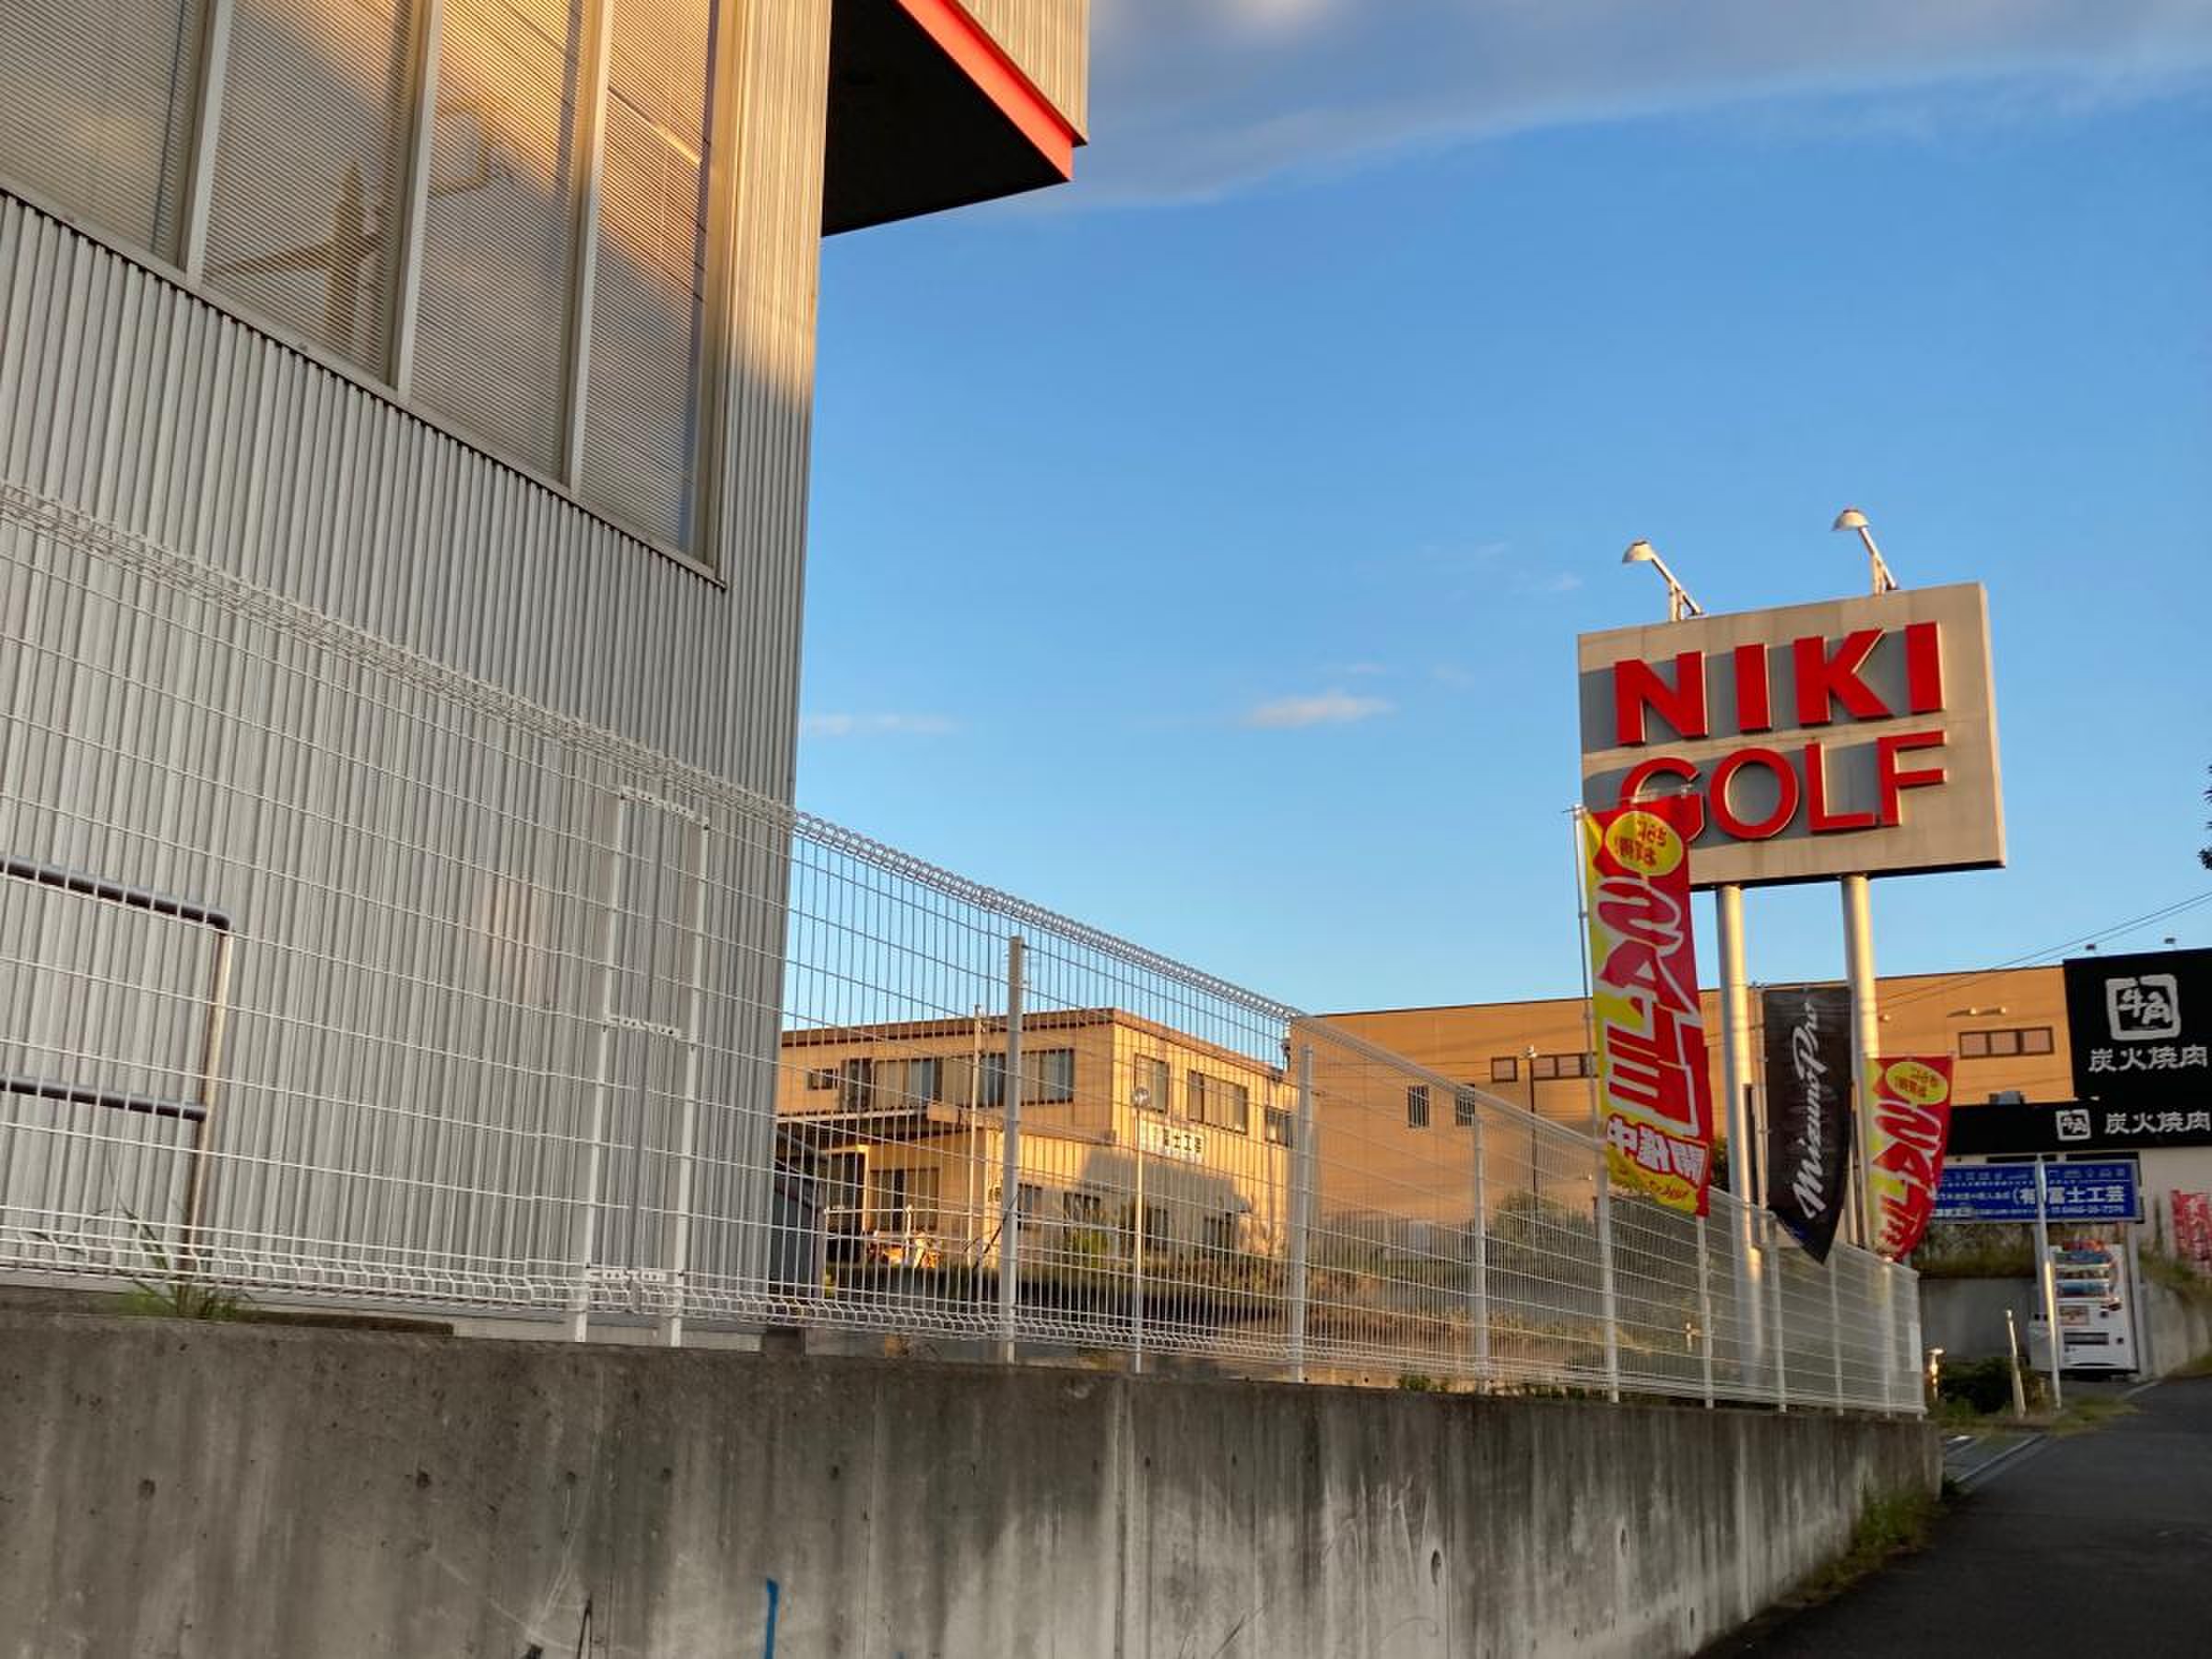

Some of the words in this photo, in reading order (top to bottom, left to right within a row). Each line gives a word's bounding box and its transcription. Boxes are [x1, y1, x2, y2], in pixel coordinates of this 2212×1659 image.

[1614, 621, 1946, 746] NIKI
[2119, 987, 2171, 1025] 牛角
[1793, 1002, 1828, 1079] Pro
[2088, 1043, 2208, 1073] 炭火焼肉
[1793, 1071, 1827, 1219] Mizuno
[2104, 1111, 2211, 1135] 炭火焼肉
